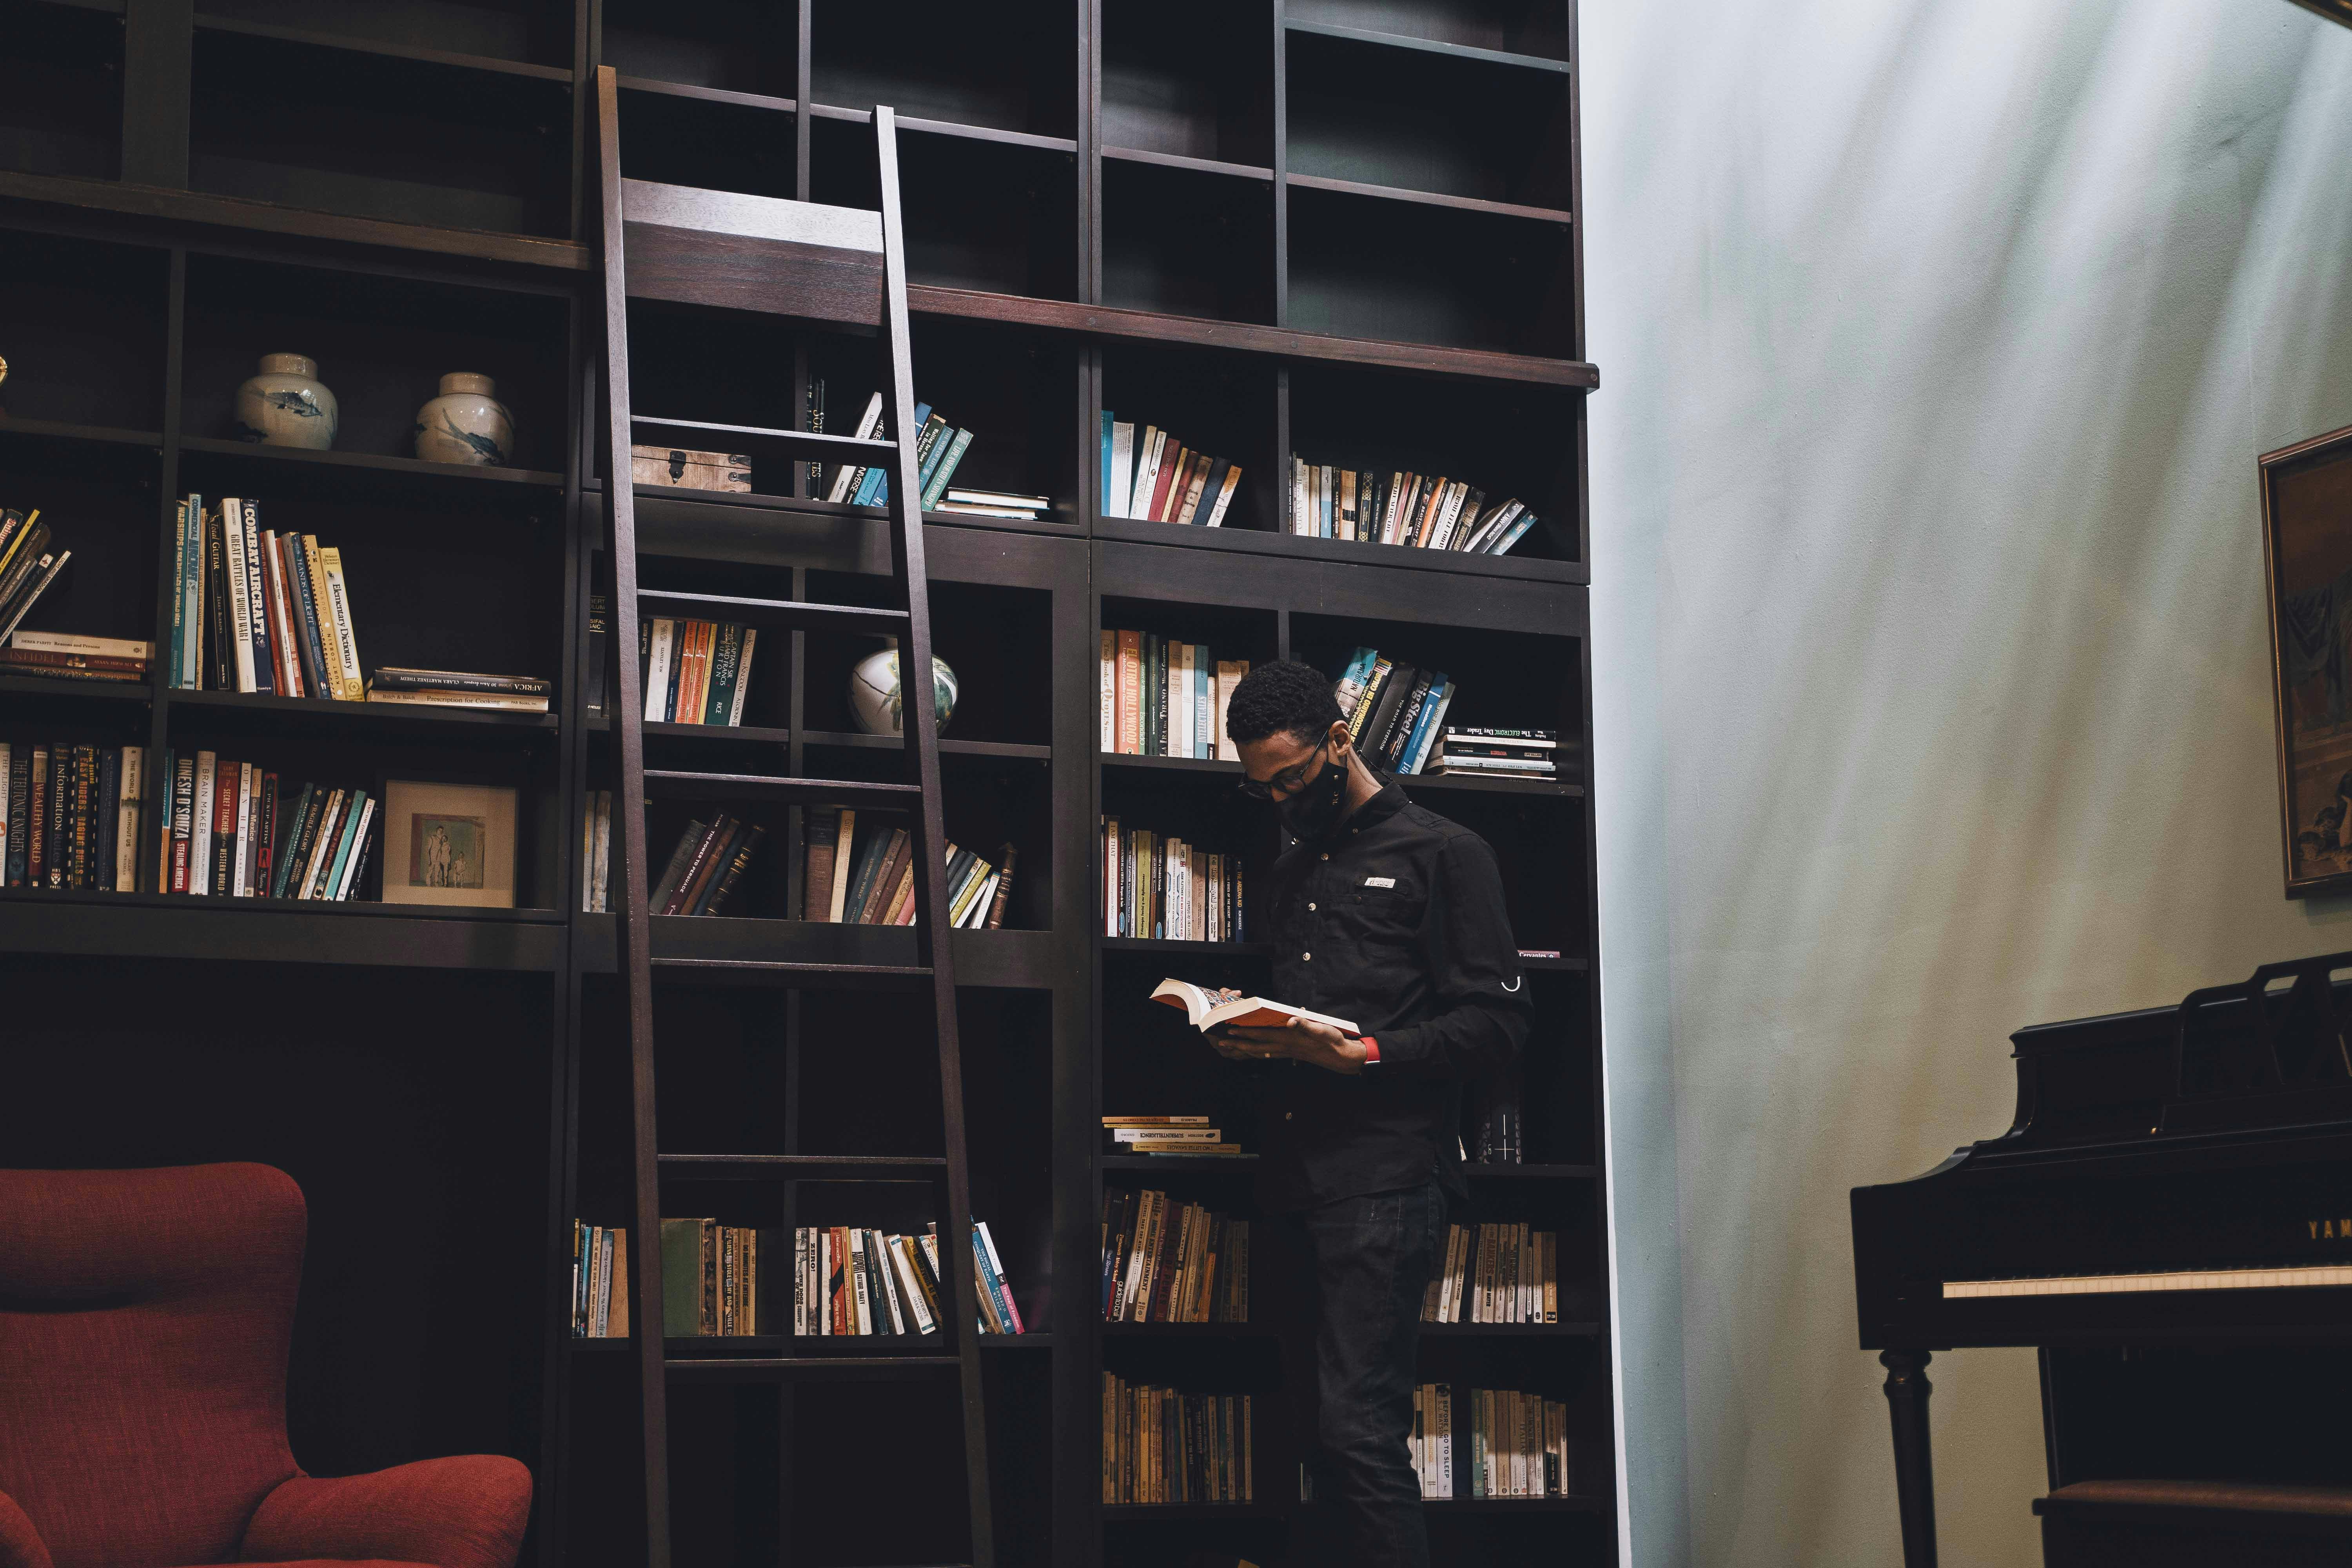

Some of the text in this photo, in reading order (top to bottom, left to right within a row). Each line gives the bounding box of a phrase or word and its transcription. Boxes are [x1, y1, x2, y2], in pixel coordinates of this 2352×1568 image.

[916, 437, 928, 452] Havana
[926, 428, 940, 444] Waiting
[918, 450, 927, 462] Snow
[211, 523, 220, 540] Total
[1414, 506, 1425, 538] BRAVEHEART
[231, 534, 241, 555] GREAT
[188, 539, 198, 581] AIRCRAFT
[232, 558, 243, 586] BATTLES
[244, 508, 265, 635] COMBAT AIRCRAFT
[236, 598, 247, 620] WORLD
[317, 577, 327, 614] JOURNALS
[238, 622, 248, 638] WAR
[333, 584, 352, 670] Elementary Dictionary
[9, 652, 56, 663] INFIDEL
[716, 641, 726, 677] BURTON
[720, 633, 733, 686] RICHARD FRANCIS
[729, 642, 737, 668] CAPTAIN
[695, 660, 704, 697] MOONWALKING
[1350, 662, 1366, 691] NATURAMA
[426, 696, 463, 704] Prescription
[1101, 688, 1112, 725] QUOTES
[1125, 648, 1139, 744] EL OTRO HOLLYWOOD
[1350, 671, 1383, 736] DICCIONARIO EN COLOR
[1400, 679, 1430, 735] Big Steel
[1437, 695, 1446, 708] Solo
[1197, 696, 1206, 742] INTELECTUALES
[1427, 719, 1436, 731] Hoy
[79, 757, 88, 777] EASY
[11, 759, 27, 852] THE TEUTONIC KNIGHTS
[175, 759, 193, 838] DINESH D'SOUZA
[31, 784, 44, 862] WEALTHY WORLD
[76, 817, 86, 846] RAGING
[301, 804, 318, 851] FRAGILE GLORY
[75, 849, 84, 874] BULLS
[697, 840, 709, 858] POWER
[175, 844, 185, 888] STEALING AMERICA
[290, 859, 299, 883] BERNSTEIN
[295, 862, 303, 882] RICHARD
[679, 866, 696, 893] PERSUADE
[2308, 1219, 2352, 1239] YAM
[851, 1251, 865, 1273] AIRPORT
[973, 1241, 984, 1263] CONQUEST
[1485, 1239, 1494, 1274] BANKERS
[1443, 1434, 1448, 1443] GO
[1444, 1445, 1448, 1454] TO
